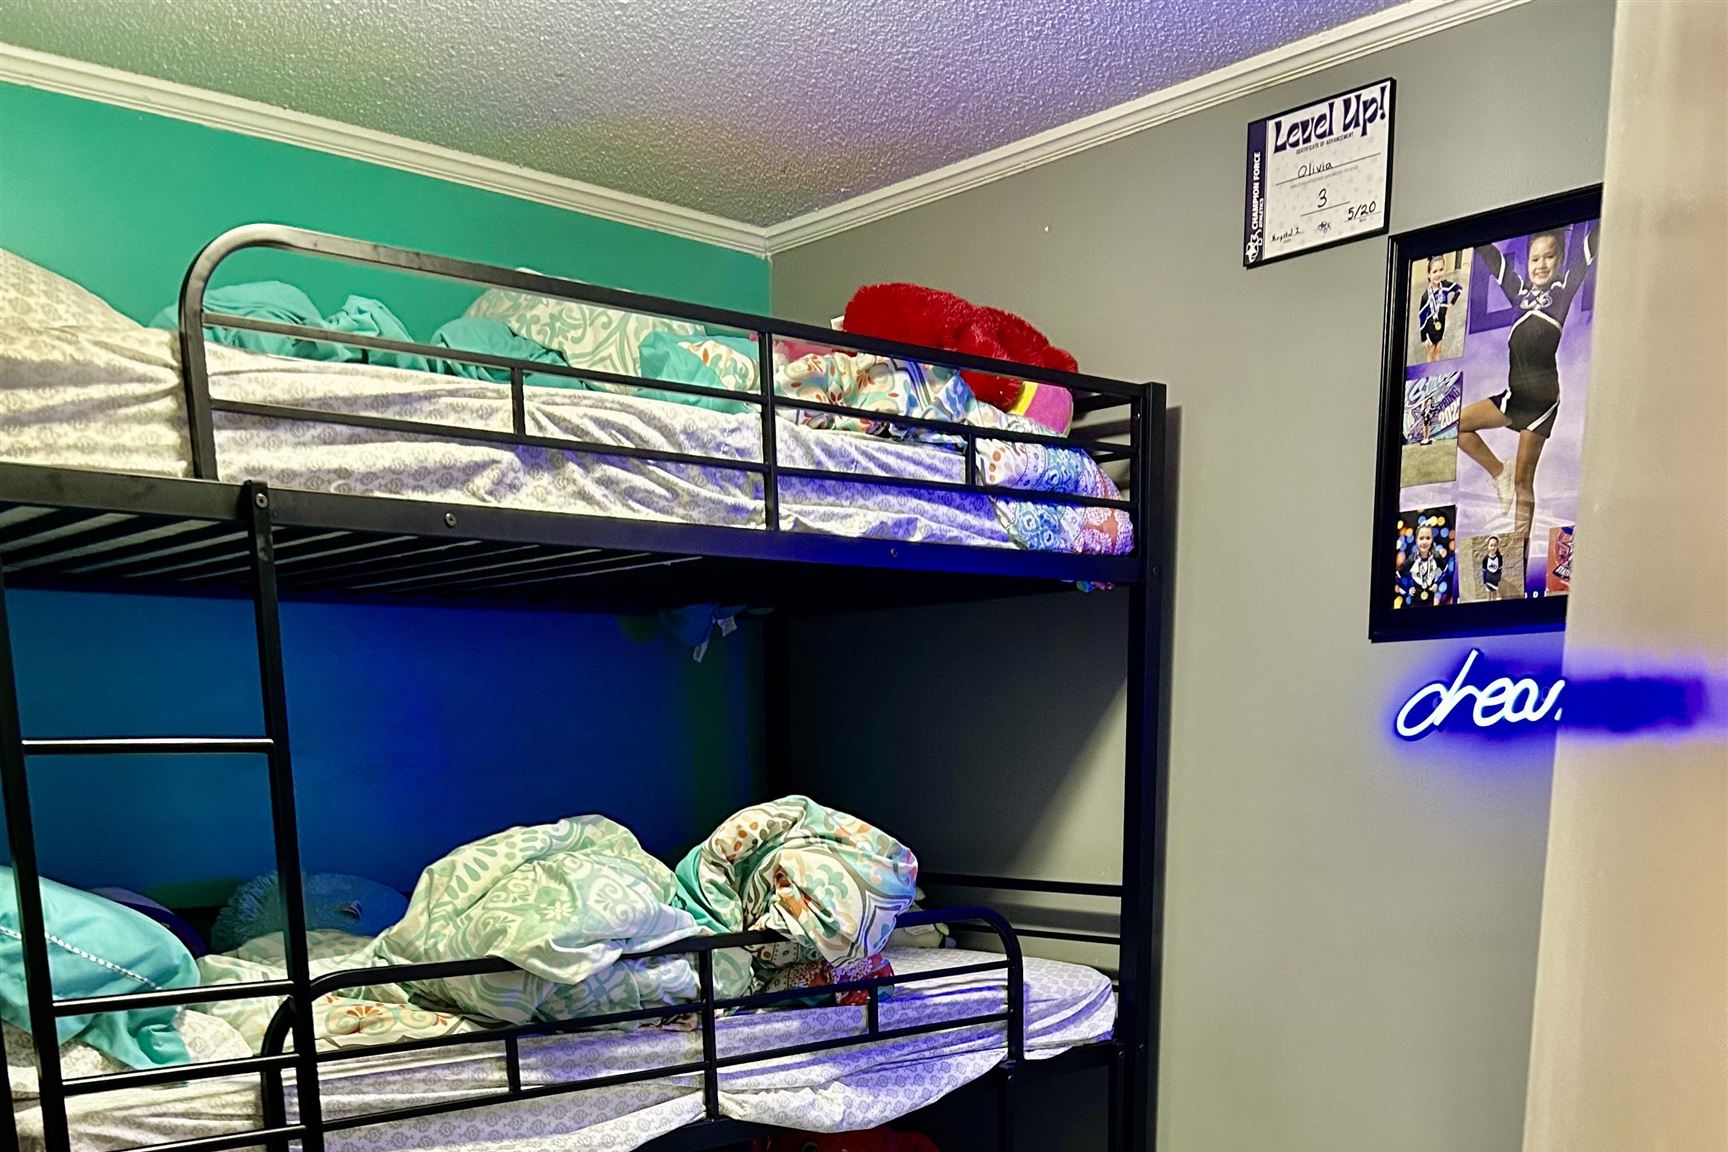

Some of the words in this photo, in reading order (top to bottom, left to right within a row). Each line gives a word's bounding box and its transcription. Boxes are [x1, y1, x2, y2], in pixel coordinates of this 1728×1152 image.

[1274, 101, 1336, 154] Level
[1342, 85, 1388, 137] Up!
[1253, 152, 1261, 181] FORCE
[1298, 162, 1333, 179] Olivia
[1252, 182, 1260, 230] CHAMPION
[1317, 188, 1328, 208] 3
[1348, 201, 1377, 221] 5/20
[1396, 648, 1566, 737] drea
